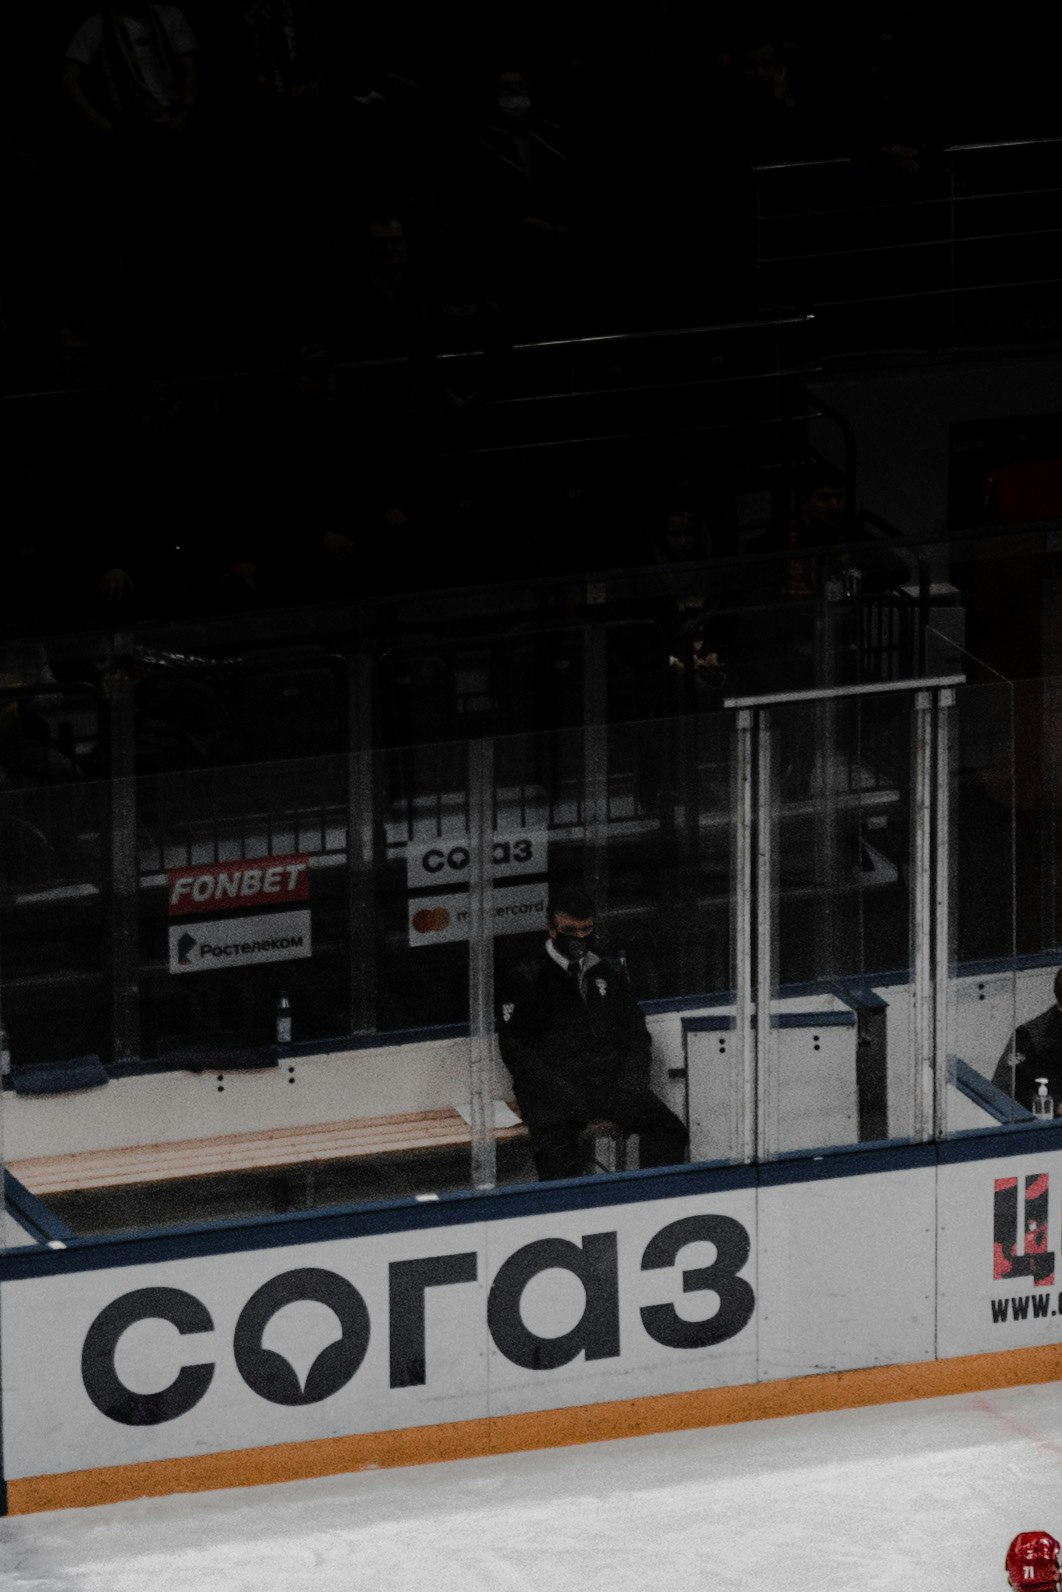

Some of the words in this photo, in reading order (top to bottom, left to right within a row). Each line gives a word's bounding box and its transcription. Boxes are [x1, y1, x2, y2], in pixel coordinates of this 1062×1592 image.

[422, 839, 533, 873] соаз
[170, 864, 308, 905] FONBET
[457, 898, 544, 922] mercard
[200, 935, 304, 959] Ростелеком
[1023, 1566, 1035, 1580] 71
